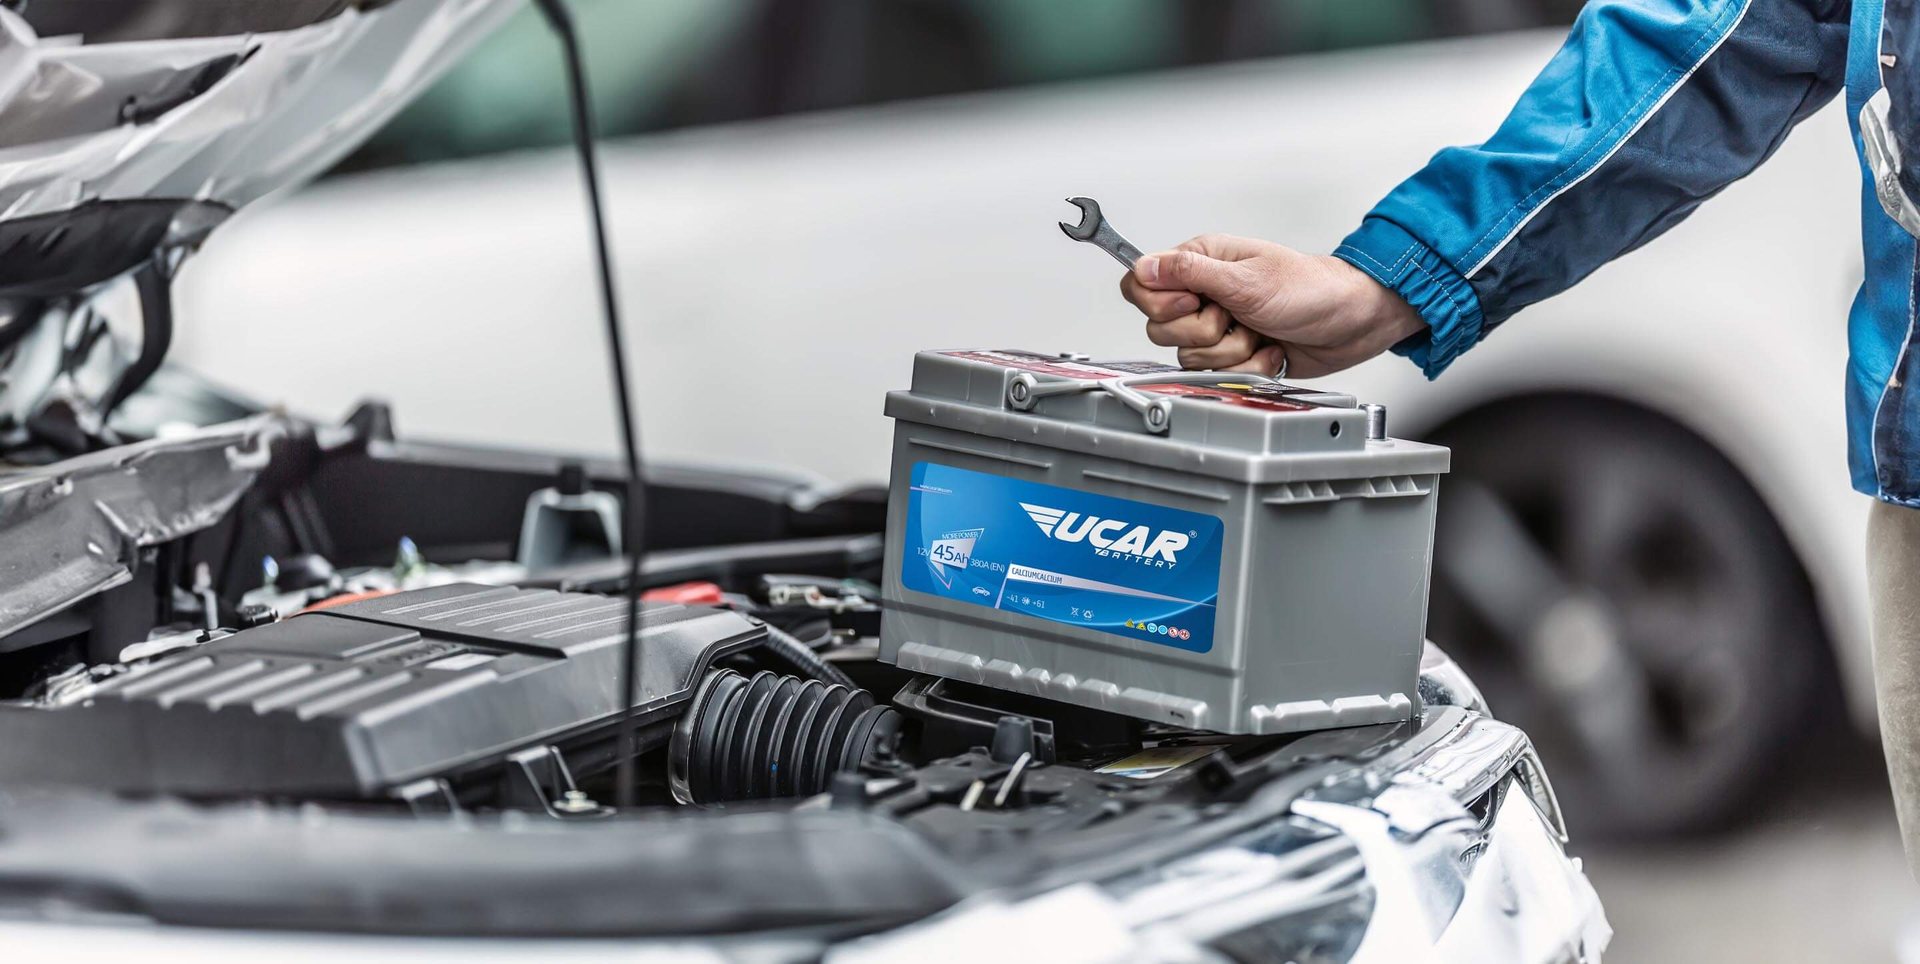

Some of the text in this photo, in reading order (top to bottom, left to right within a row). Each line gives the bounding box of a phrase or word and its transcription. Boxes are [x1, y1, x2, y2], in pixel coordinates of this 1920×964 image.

[1054, 512, 1189, 563] UCAR
[917, 544, 1005, 573] 12V 45Ah 380A (EN)
[1100, 548, 1176, 570] BATTERY
